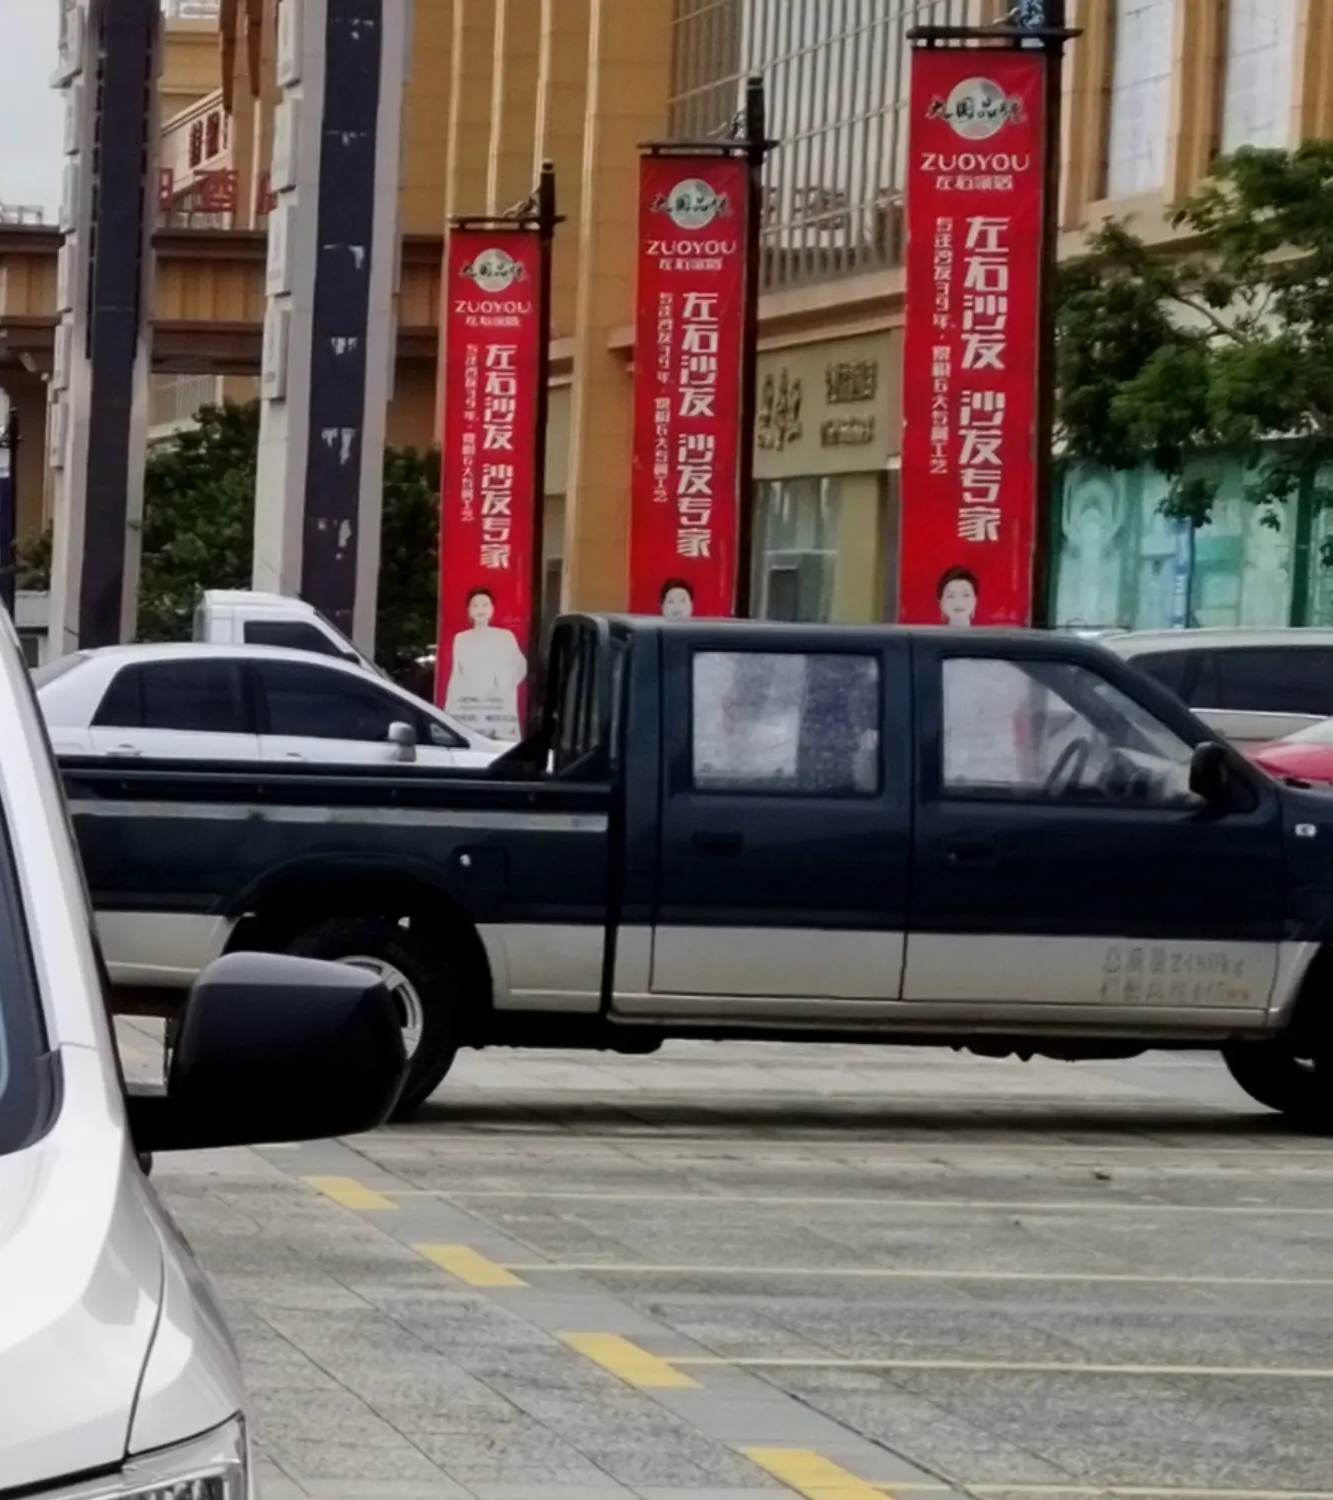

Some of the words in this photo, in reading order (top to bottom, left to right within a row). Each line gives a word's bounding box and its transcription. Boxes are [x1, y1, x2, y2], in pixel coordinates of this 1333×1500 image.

[920, 153, 1030, 171] ZUOYOU
[646, 240, 737, 255] ZUOYOU
[961, 216, 1013, 370] 左右沙发
[454, 300, 532, 314] ZUOYOU
[678, 292, 719, 417] 左右沙发
[483, 344, 517, 450] 左右沙发
[480, 463, 514, 570] 沙发专家
[676, 434, 715, 558] 沙发专家
[957, 389, 1007, 542] 沙发专家
